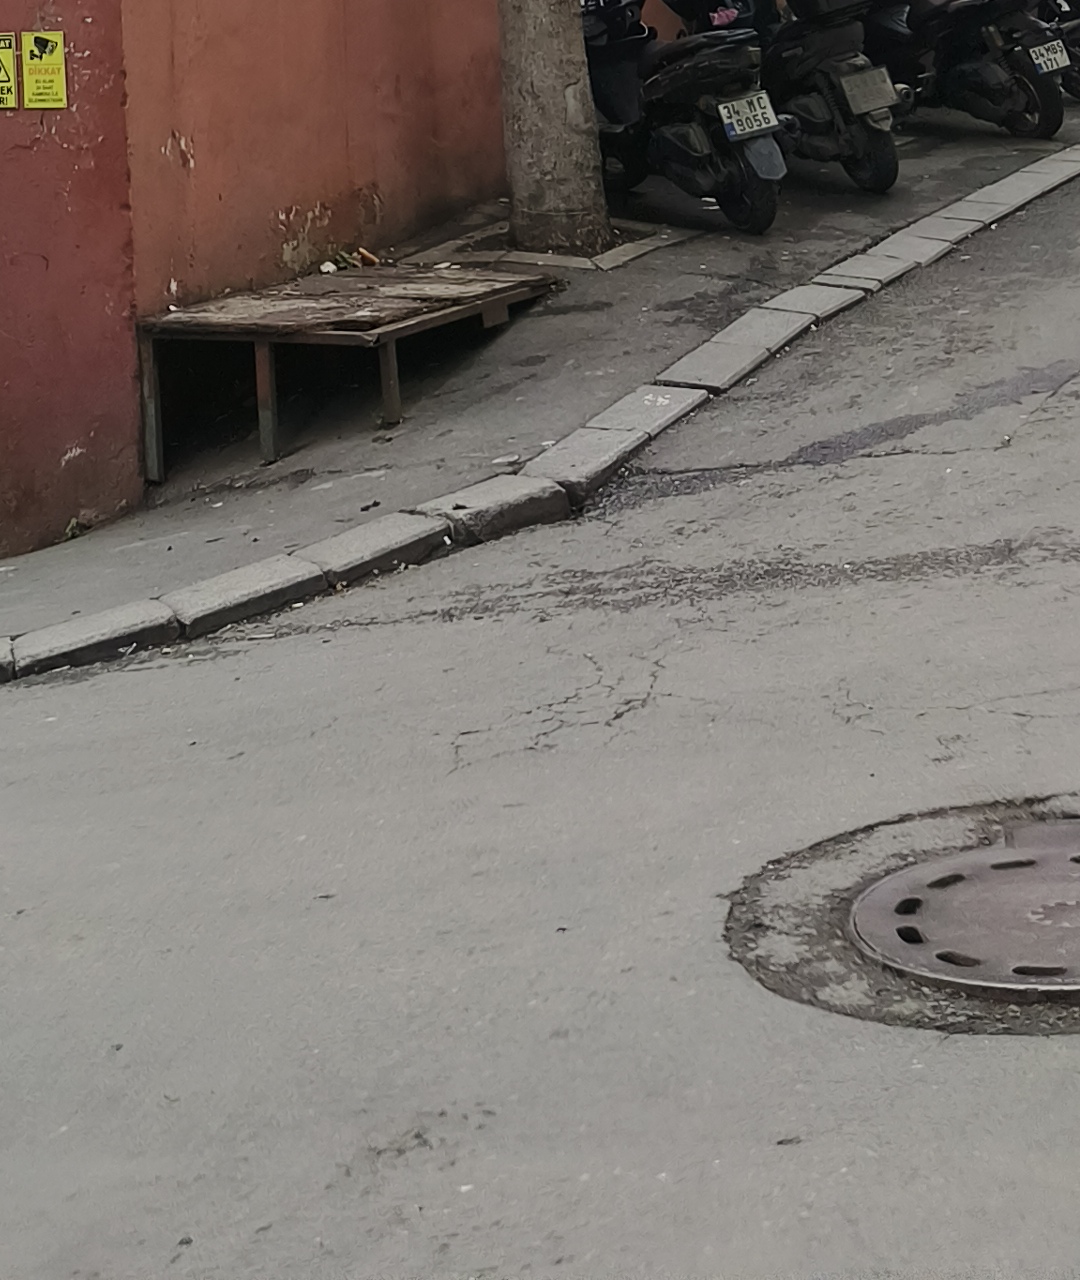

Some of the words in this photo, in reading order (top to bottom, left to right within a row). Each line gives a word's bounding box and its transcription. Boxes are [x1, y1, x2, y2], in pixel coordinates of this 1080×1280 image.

[1031, 49, 1045, 61] 34
[1043, 56, 1060, 70] 171
[28, 65, 62, 76] DİKKAT
[723, 103, 741, 120] 34
[736, 111, 772, 132] 9056
